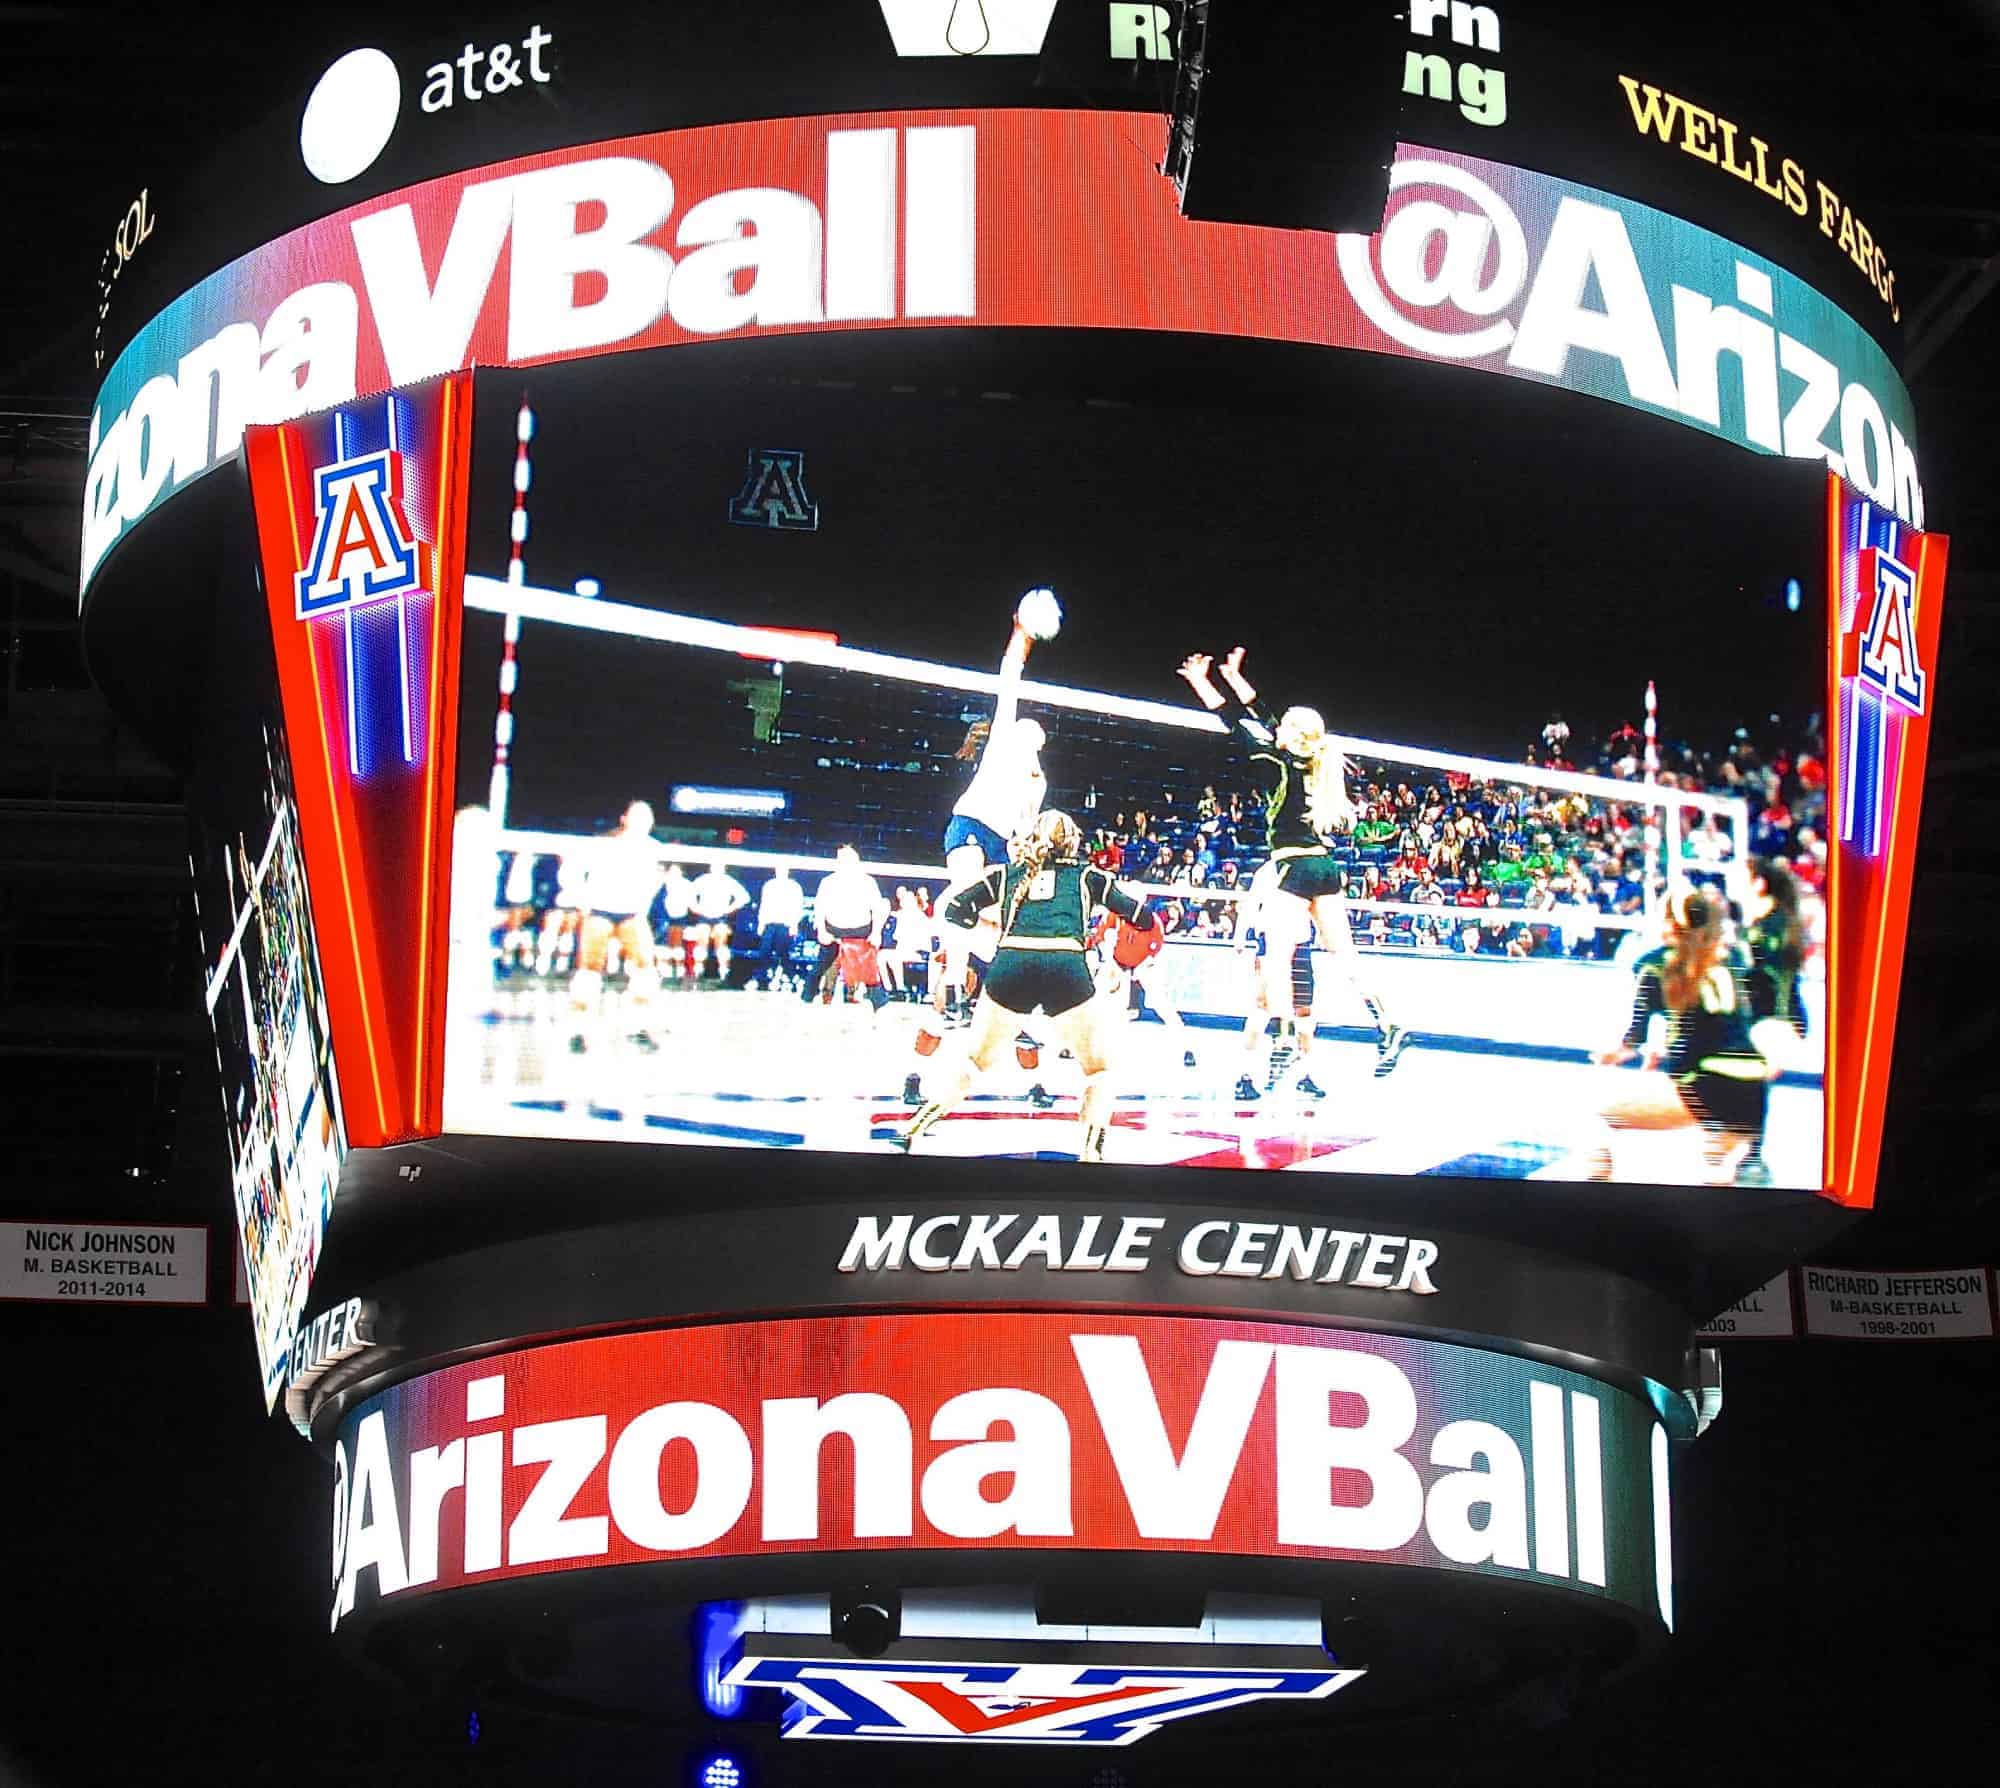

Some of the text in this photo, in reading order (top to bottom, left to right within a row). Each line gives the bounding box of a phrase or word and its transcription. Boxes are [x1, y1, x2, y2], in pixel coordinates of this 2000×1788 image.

[1109, 2, 1176, 61] R
[1396, 0, 1502, 53] rn
[421, 24, 552, 113] at&t
[1618, 74, 1808, 216] WELLS
[113, 187, 156, 280] SOL
[1336, 158, 1925, 533] @Arizon
[23, 1258, 177, 1277] M. BASKETBALL
[25, 1229, 175, 1255] NICK JOHNSON
[838, 1214, 1441, 1296] MCKALE CENTER
[57, 1279, 146, 1297] 2011-2014
[1808, 1271, 1982, 1297] RICHARD JEFFERSON
[1830, 1300, 1963, 1316] M-BASKETBALL
